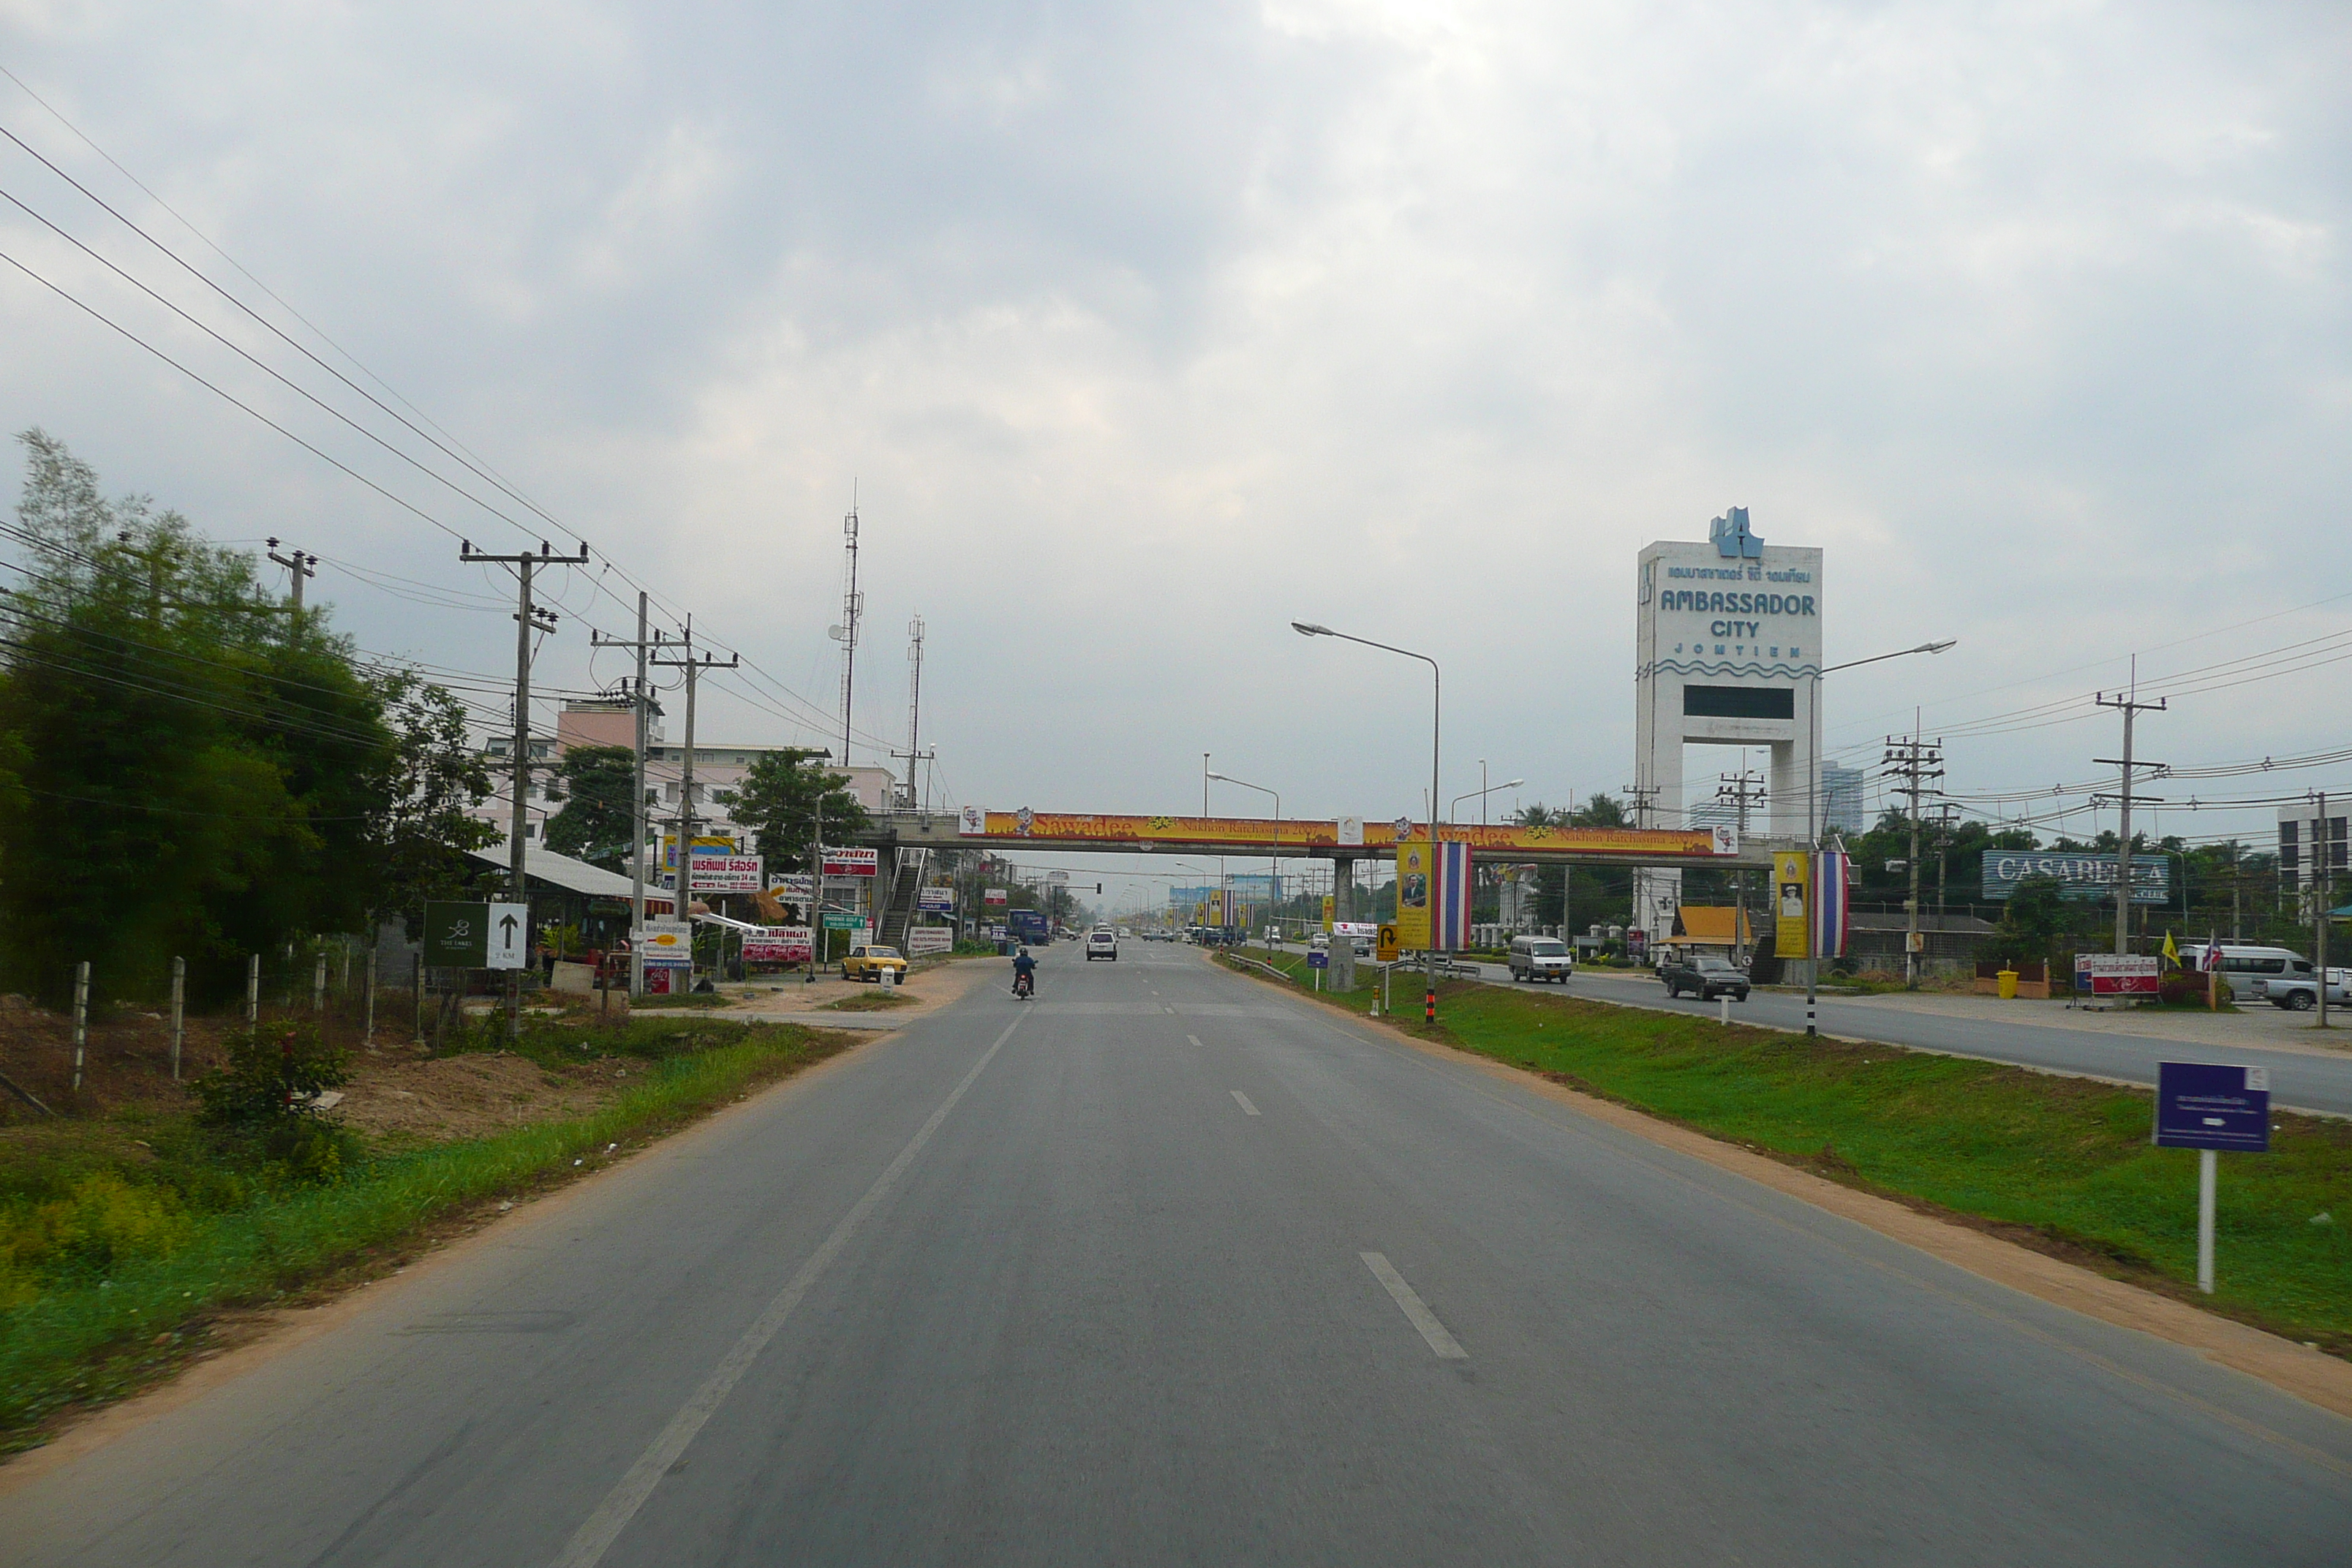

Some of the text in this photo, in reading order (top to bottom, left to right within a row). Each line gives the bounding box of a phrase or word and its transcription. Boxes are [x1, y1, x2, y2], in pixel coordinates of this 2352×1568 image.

[1661, 590, 1815, 615] AMBASSADOR
[1711, 620, 1760, 638] CITY
[1675, 643, 1800, 657] JOMTIEN
[1036, 815, 1132, 833] Sawadee
[1183, 821, 1317, 835] Nakhon Ratchasima 2007
[1414, 824, 1511, 843] Swadee
[1561, 832, 1602, 842] Nakhon
[1607, 833, 1665, 844] Ratchasima
[1670, 835, 1693, 845] 2007
